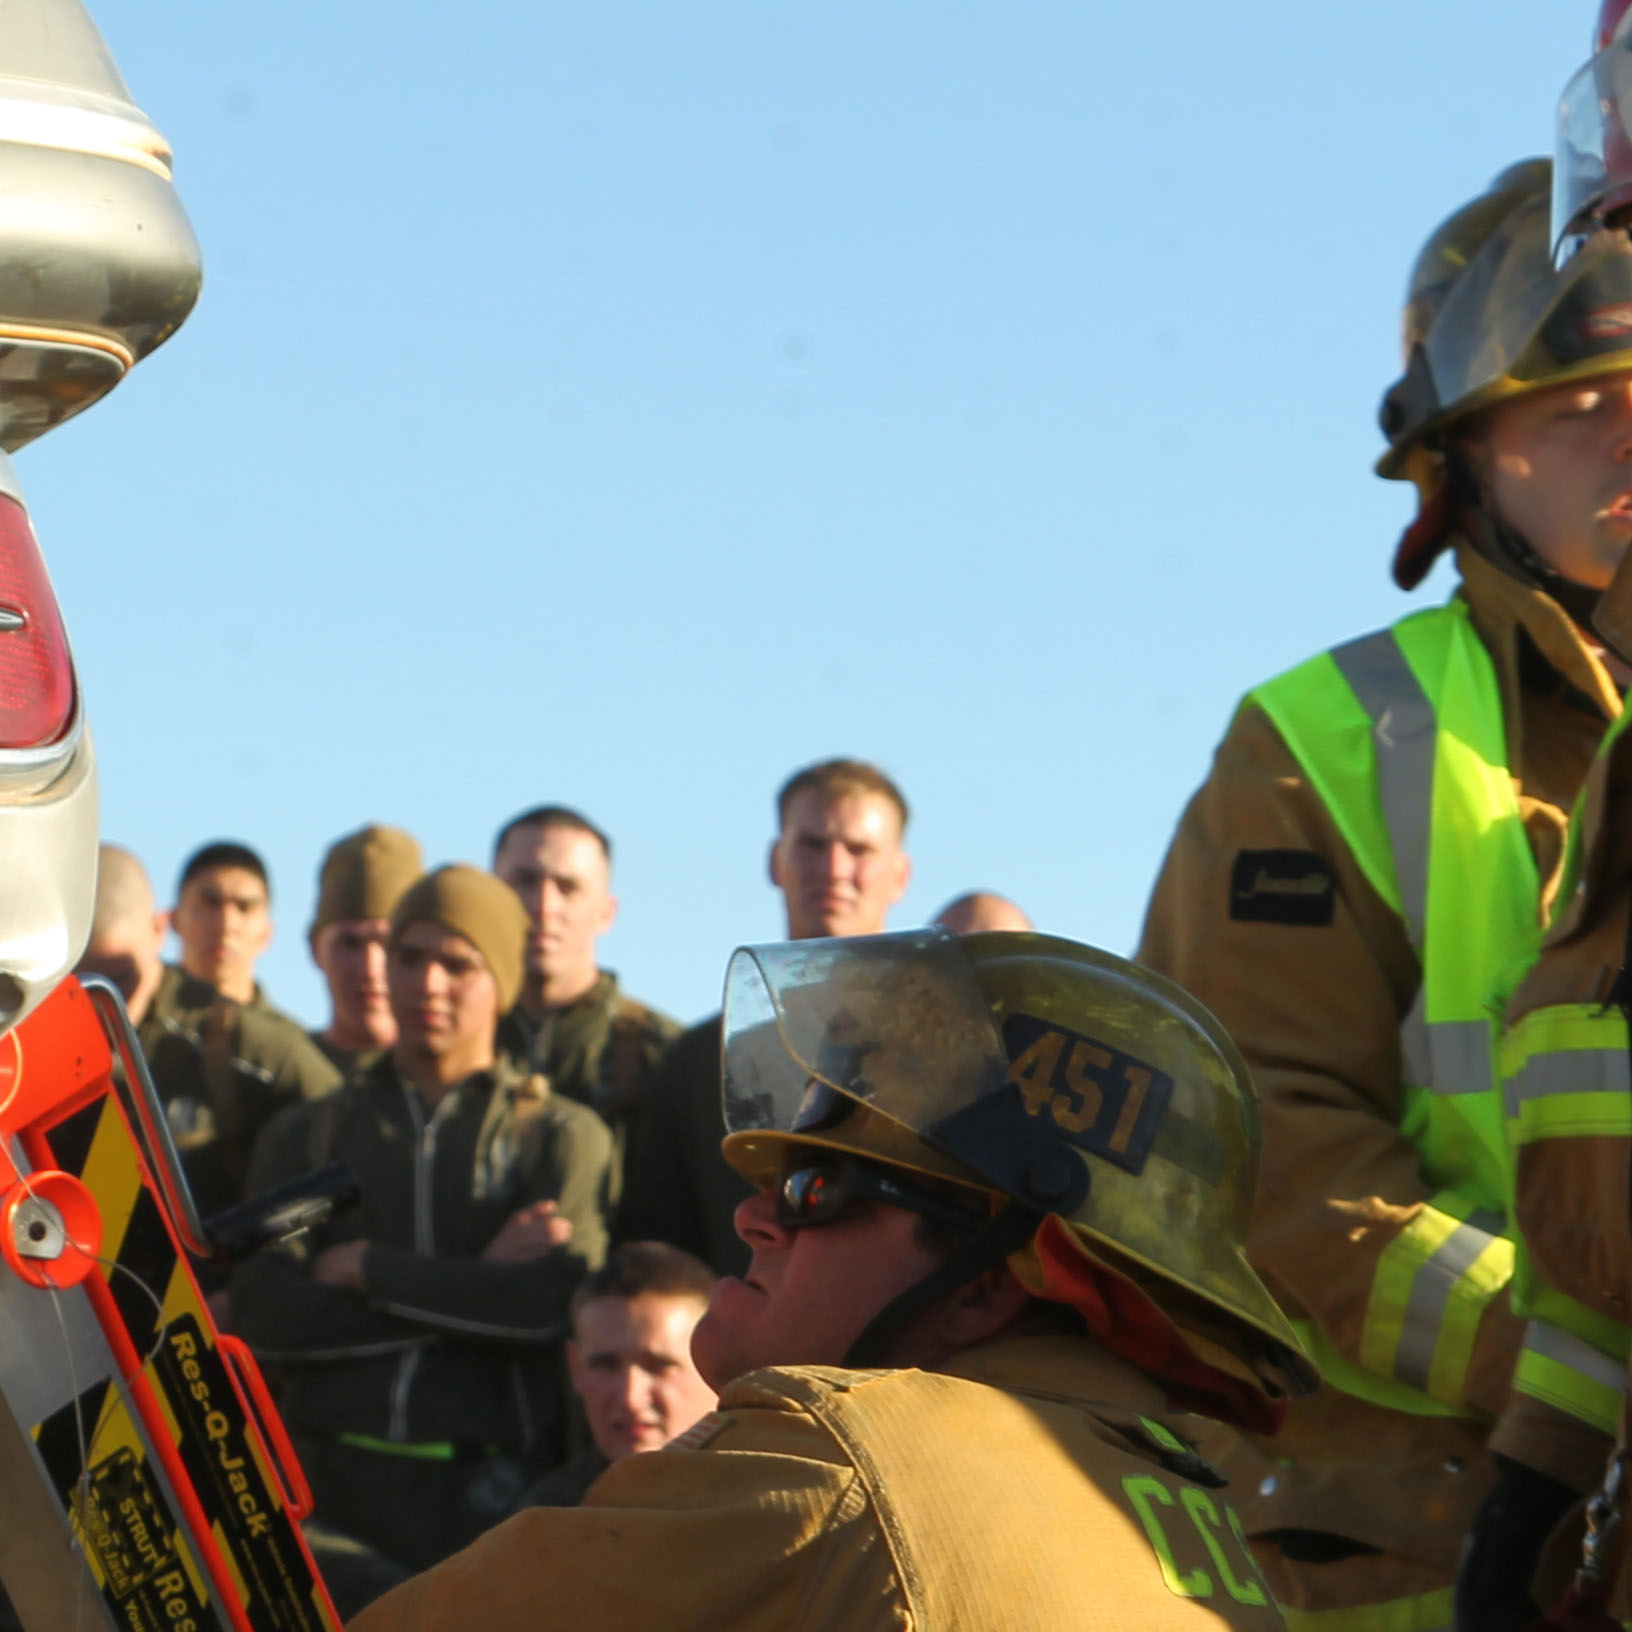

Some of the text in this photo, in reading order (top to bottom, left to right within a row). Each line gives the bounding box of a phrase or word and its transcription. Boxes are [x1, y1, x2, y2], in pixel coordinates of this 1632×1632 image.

[1009, 1029, 1153, 1156] 451
[168, 1328, 272, 1539] Res-Q-Jack
[116, 1495, 159, 1564] STRUT
[1121, 1475, 1268, 1607] CC
